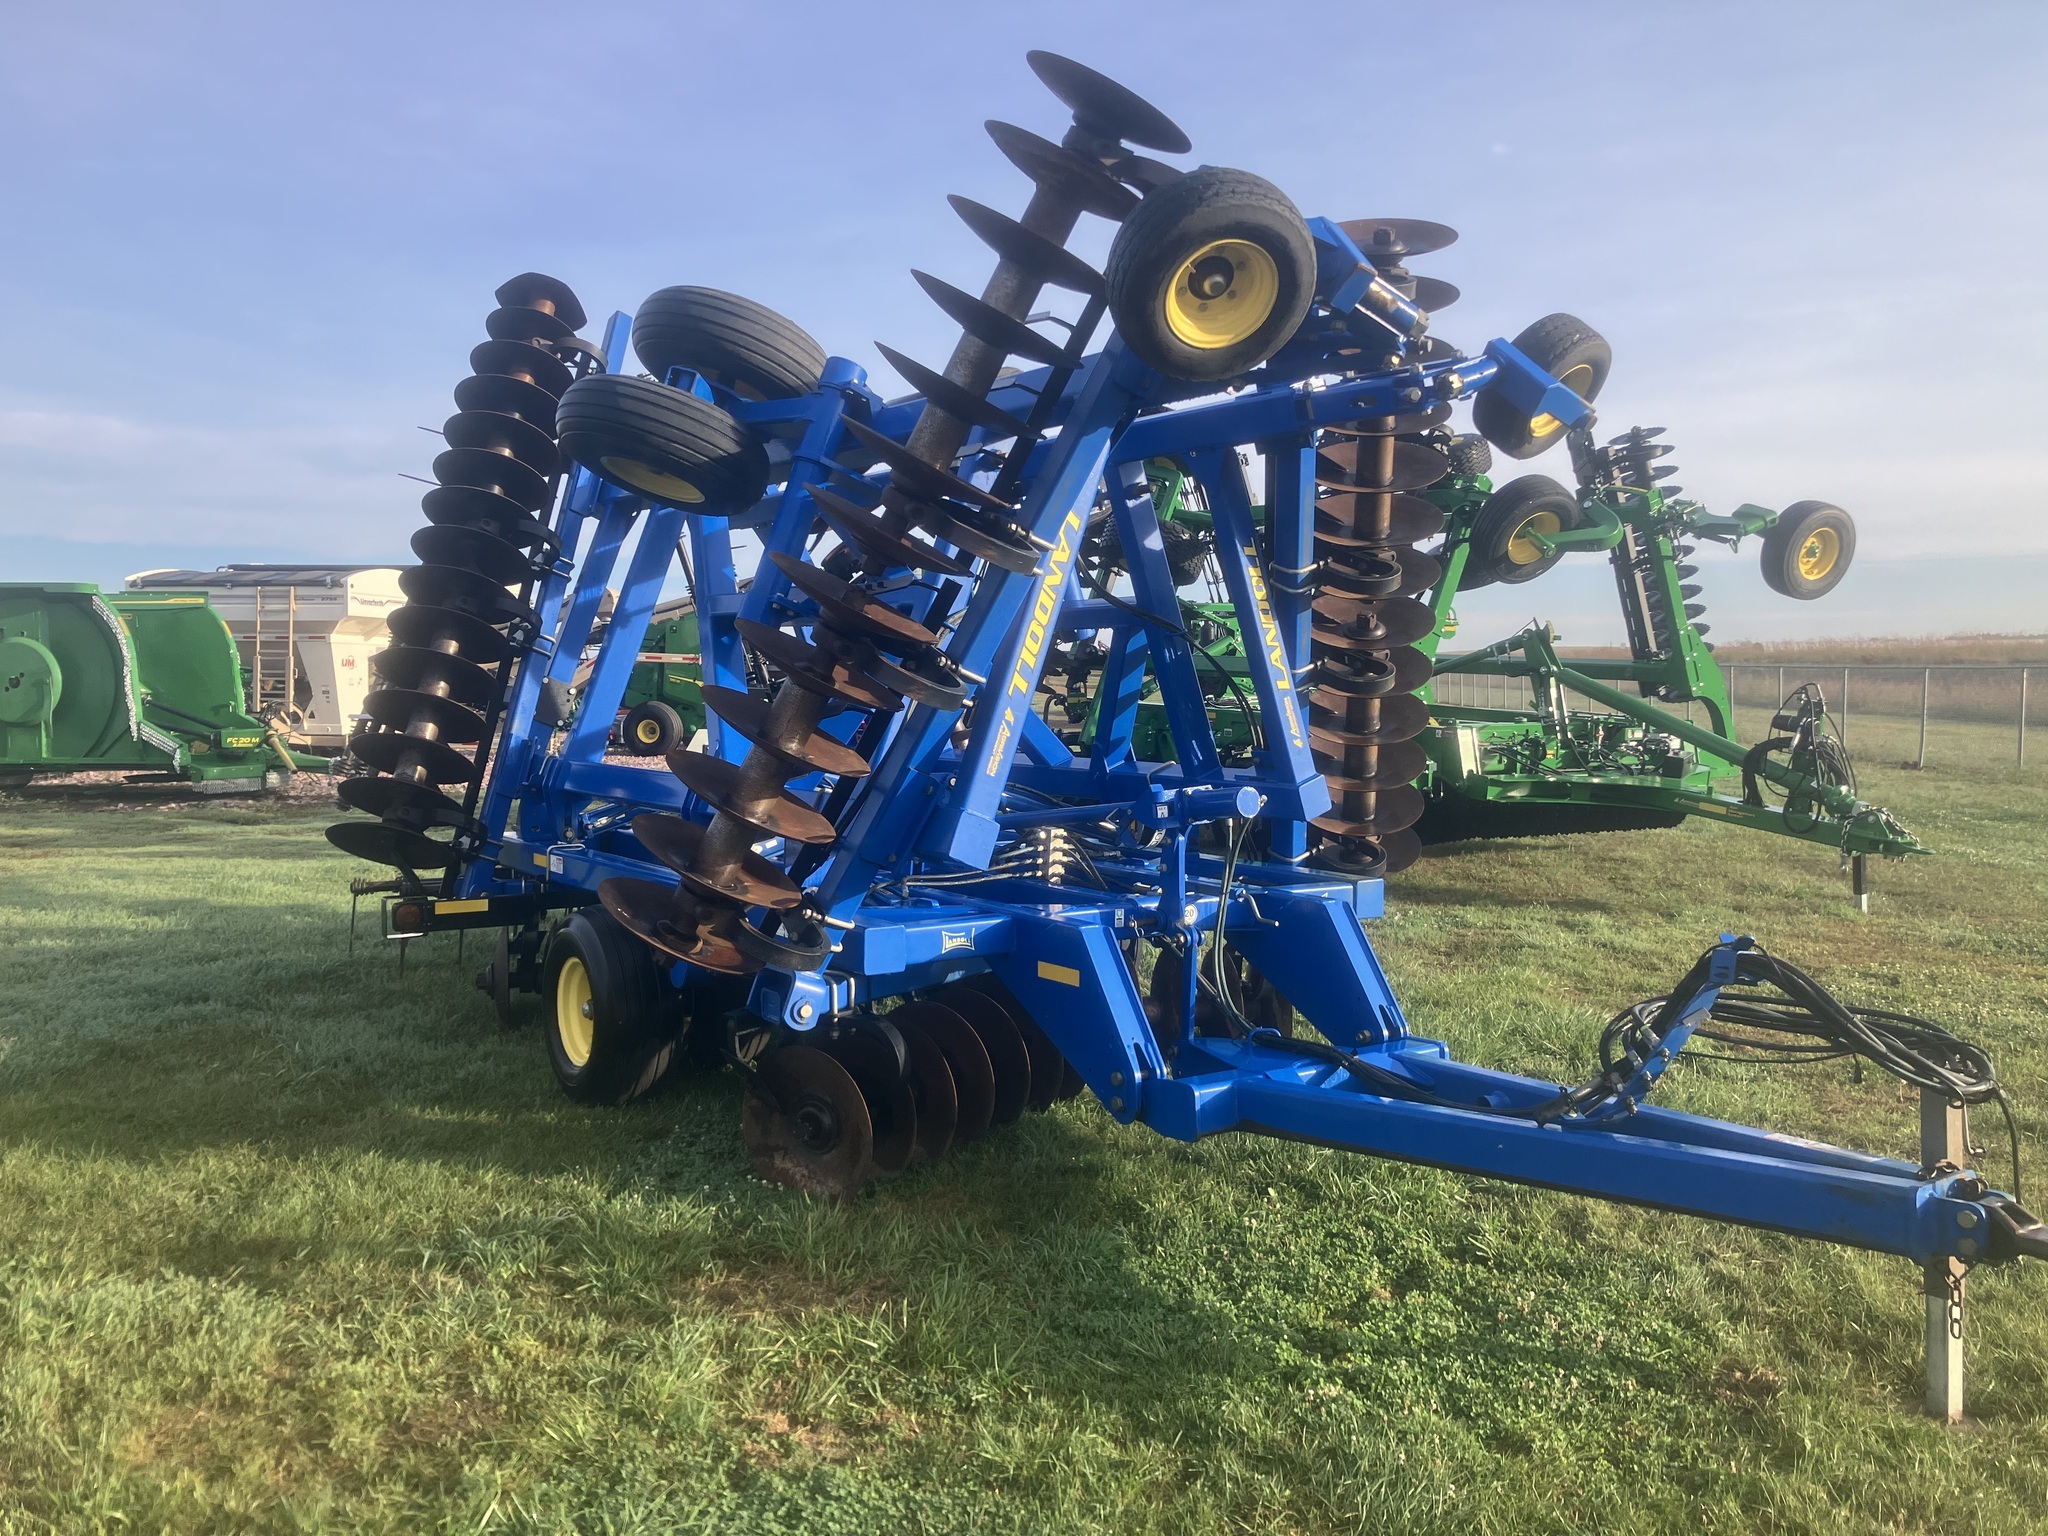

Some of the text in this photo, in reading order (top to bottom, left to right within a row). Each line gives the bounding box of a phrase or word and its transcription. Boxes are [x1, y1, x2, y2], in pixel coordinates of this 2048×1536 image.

[1007, 509, 1081, 698] LANDOLL
[1242, 537, 1292, 692] LANDOLL
[945, 935, 971, 949] LANDOLL
[1185, 909, 1195, 918] 20
